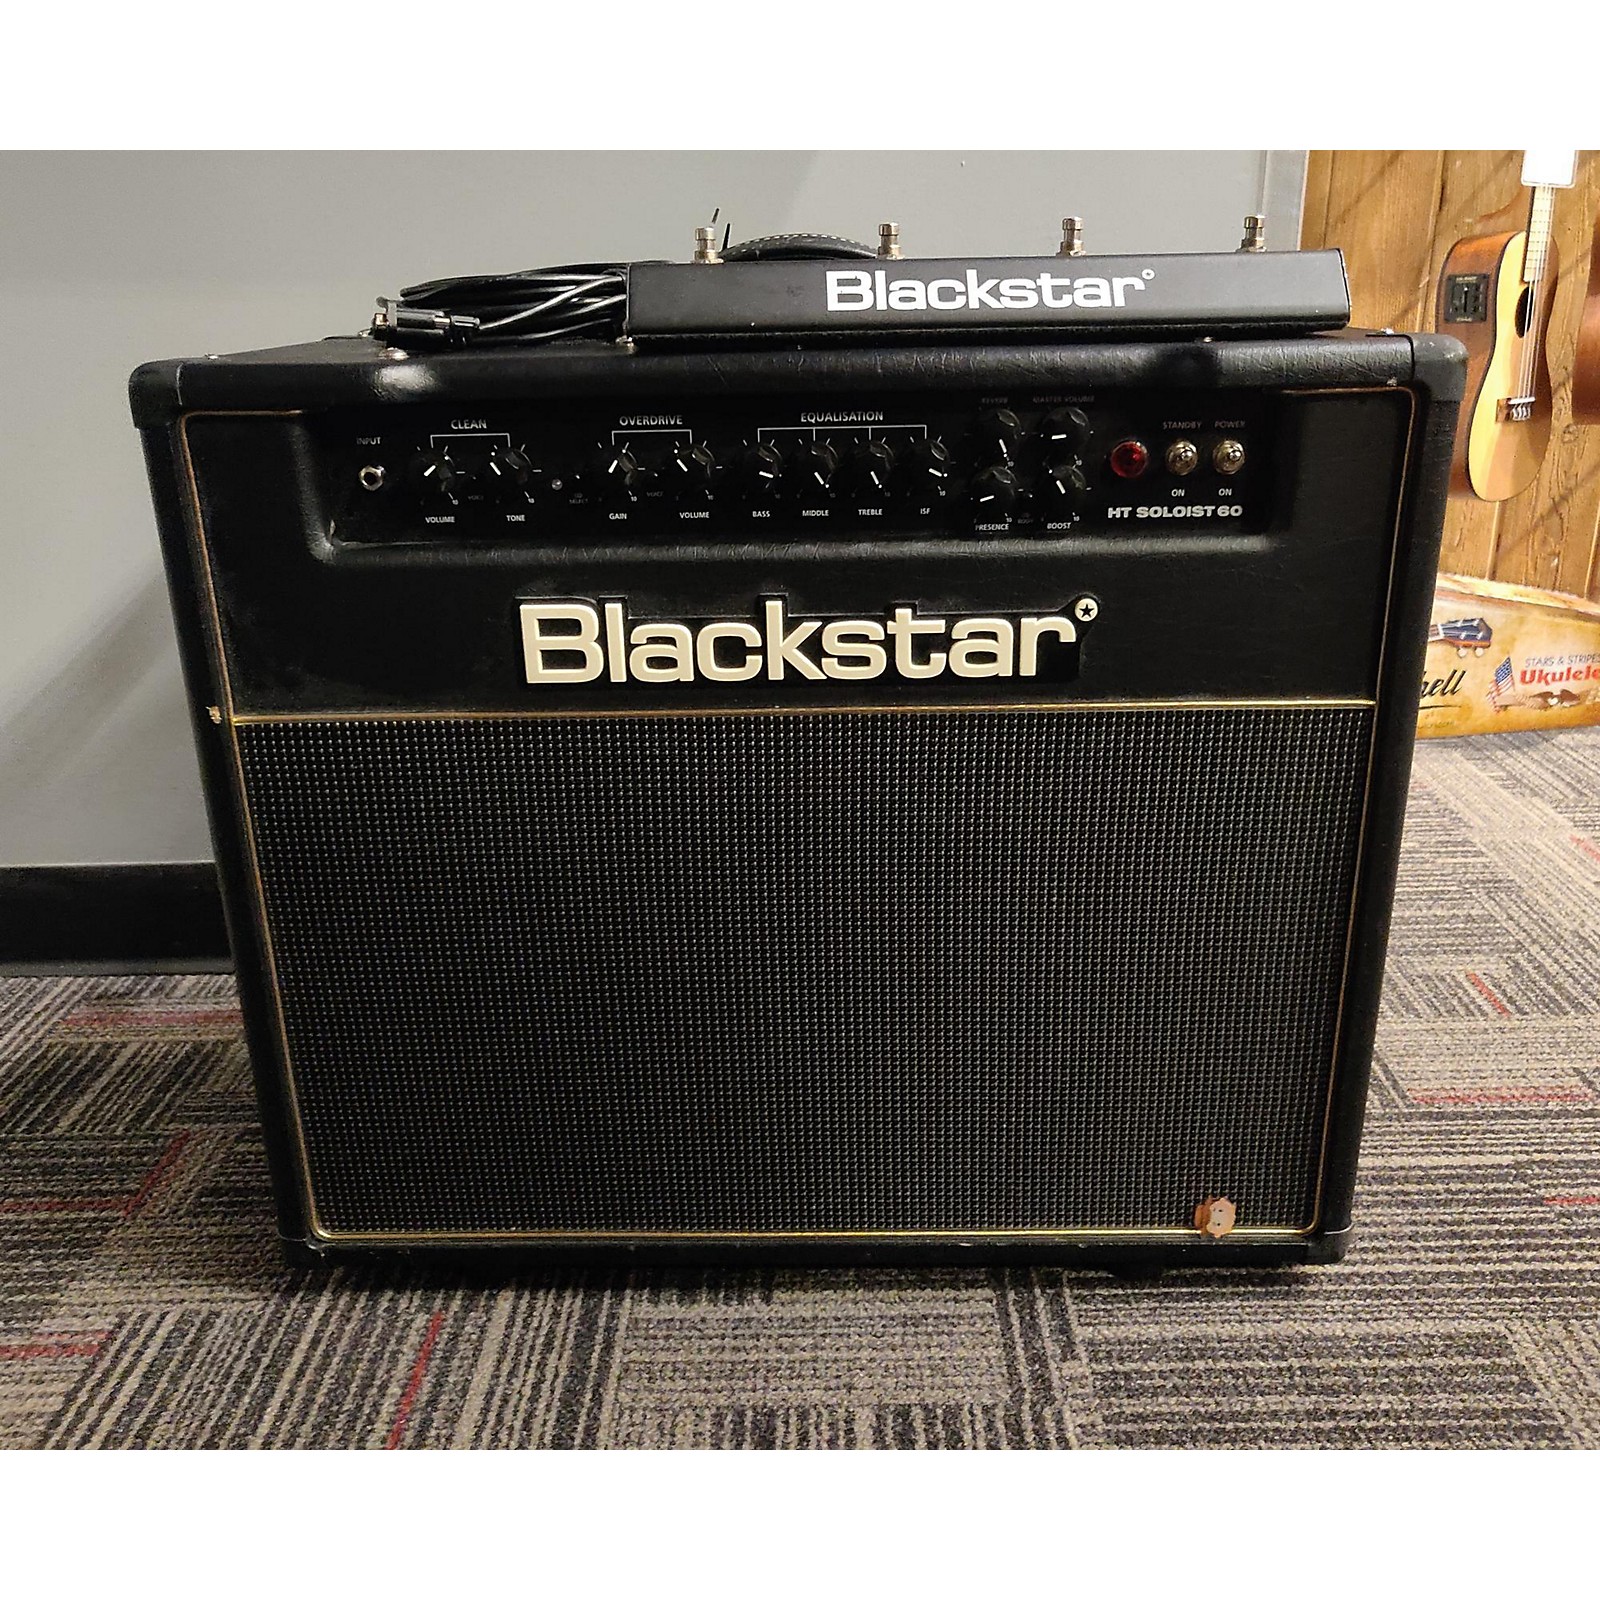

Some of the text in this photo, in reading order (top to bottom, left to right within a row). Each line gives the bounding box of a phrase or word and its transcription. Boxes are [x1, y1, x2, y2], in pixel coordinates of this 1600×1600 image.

[825, 269, 1146, 312] Blackstar
[619, 415, 683, 426] OVERDRIVE
[800, 411, 884, 424] EQUALISATION
[450, 419, 488, 430] CLEAN
[1162, 420, 1202, 430] STANDBY
[1214, 420, 1246, 429] POWER
[356, 436, 382, 446] INPUT
[1171, 488, 1185, 497] ON
[1218, 487, 1233, 496] ON
[679, 511, 710, 519] VOLUME
[752, 510, 771, 518] BASS
[802, 509, 830, 517] MIDDLE
[857, 508, 883, 516] TREBLE
[919, 507, 932, 515] ISF
[1107, 504, 1243, 519] HT SOLOIST 60
[424, 516, 456, 524] VOLUME
[506, 514, 526, 523] TONE
[608, 512, 628, 520] GAIN
[974, 523, 1010, 531] PRESENCE
[1046, 522, 1072, 530] BOOST
[518, 600, 1077, 684] Blackstar
[1525, 656, 1555, 668] STARS
[1557, 656, 1565, 666] &
